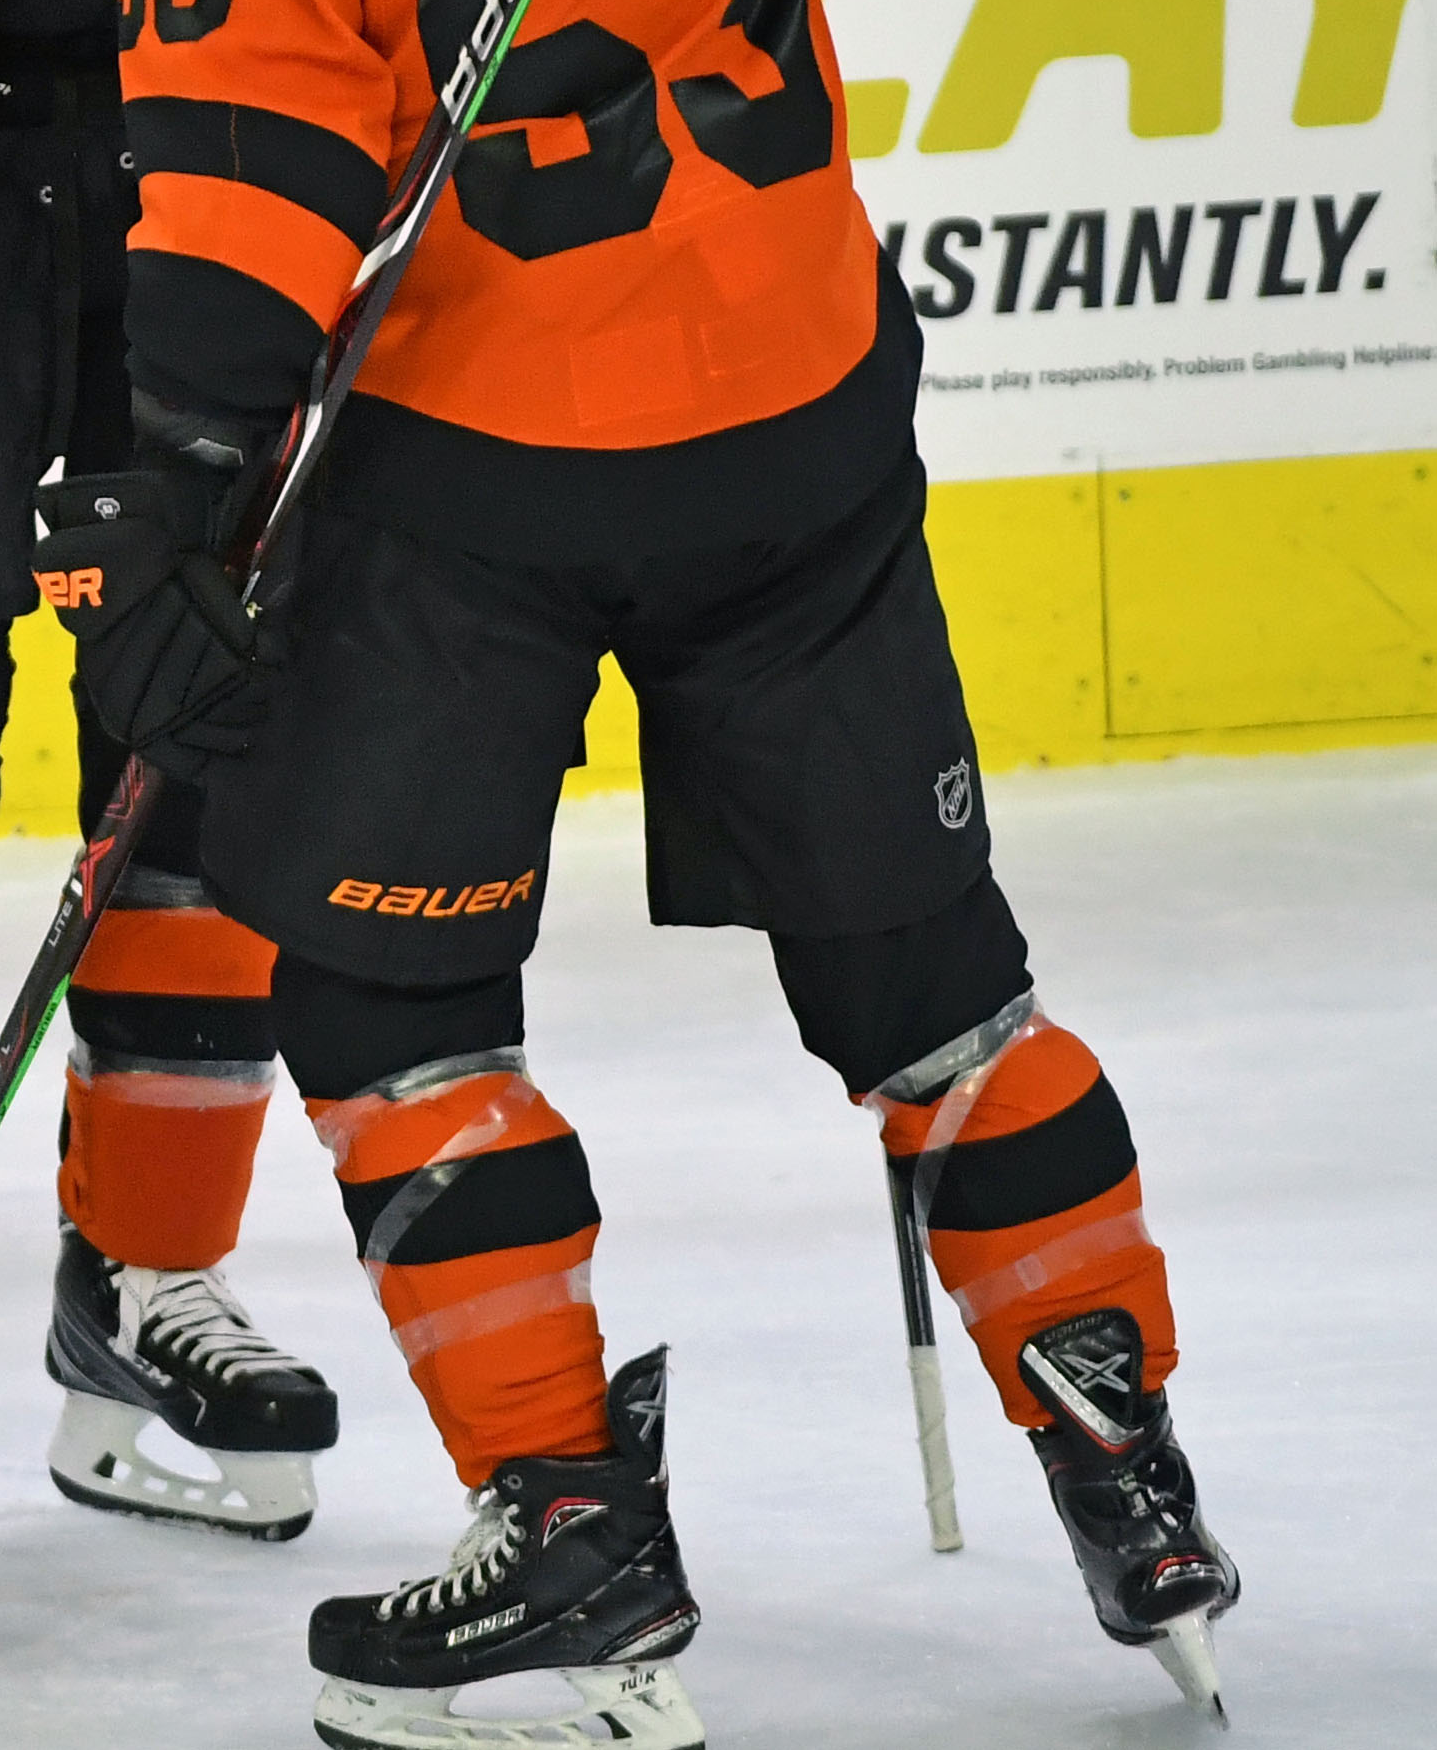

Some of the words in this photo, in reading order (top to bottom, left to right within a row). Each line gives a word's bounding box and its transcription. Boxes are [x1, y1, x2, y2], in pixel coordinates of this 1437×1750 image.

[991, 368, 1031, 391] play
[1039, 359, 1157, 388] responsibly.
[1163, 356, 1246, 376] Problem
[1252, 349, 1347, 371] Gambling
[327, 870, 537, 918] BAUER
[48, 901, 75, 948] LITE
